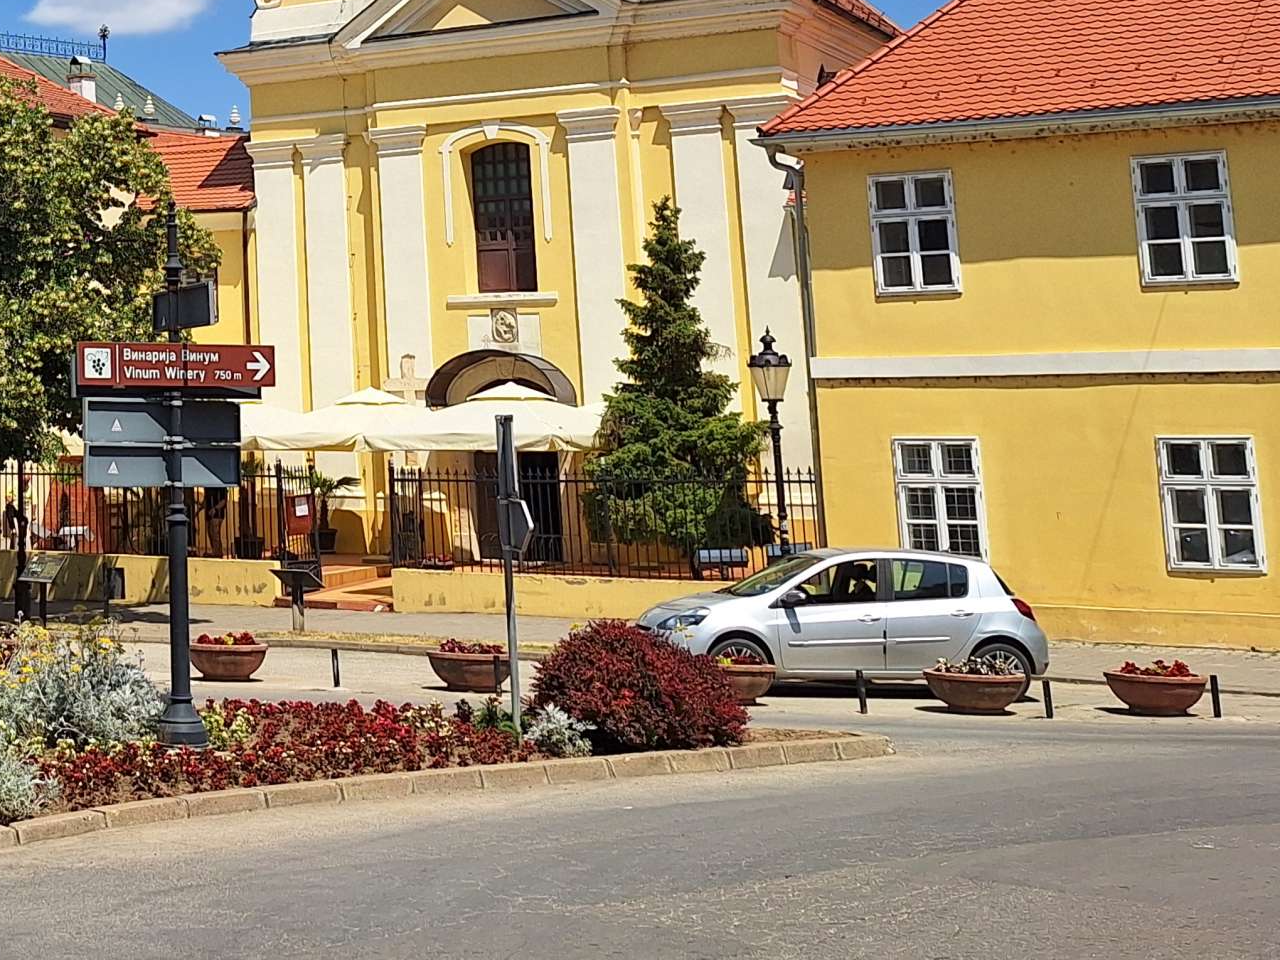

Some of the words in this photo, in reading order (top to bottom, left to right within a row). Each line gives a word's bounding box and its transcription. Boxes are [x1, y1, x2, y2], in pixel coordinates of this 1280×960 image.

[123, 348, 176, 364] Винарија
[182, 349, 219, 364] Винум
[123, 366, 161, 379] Vinum
[164, 366, 206, 382] Winery
[214, 370, 232, 380] 750
[233, 371, 242, 380] m
